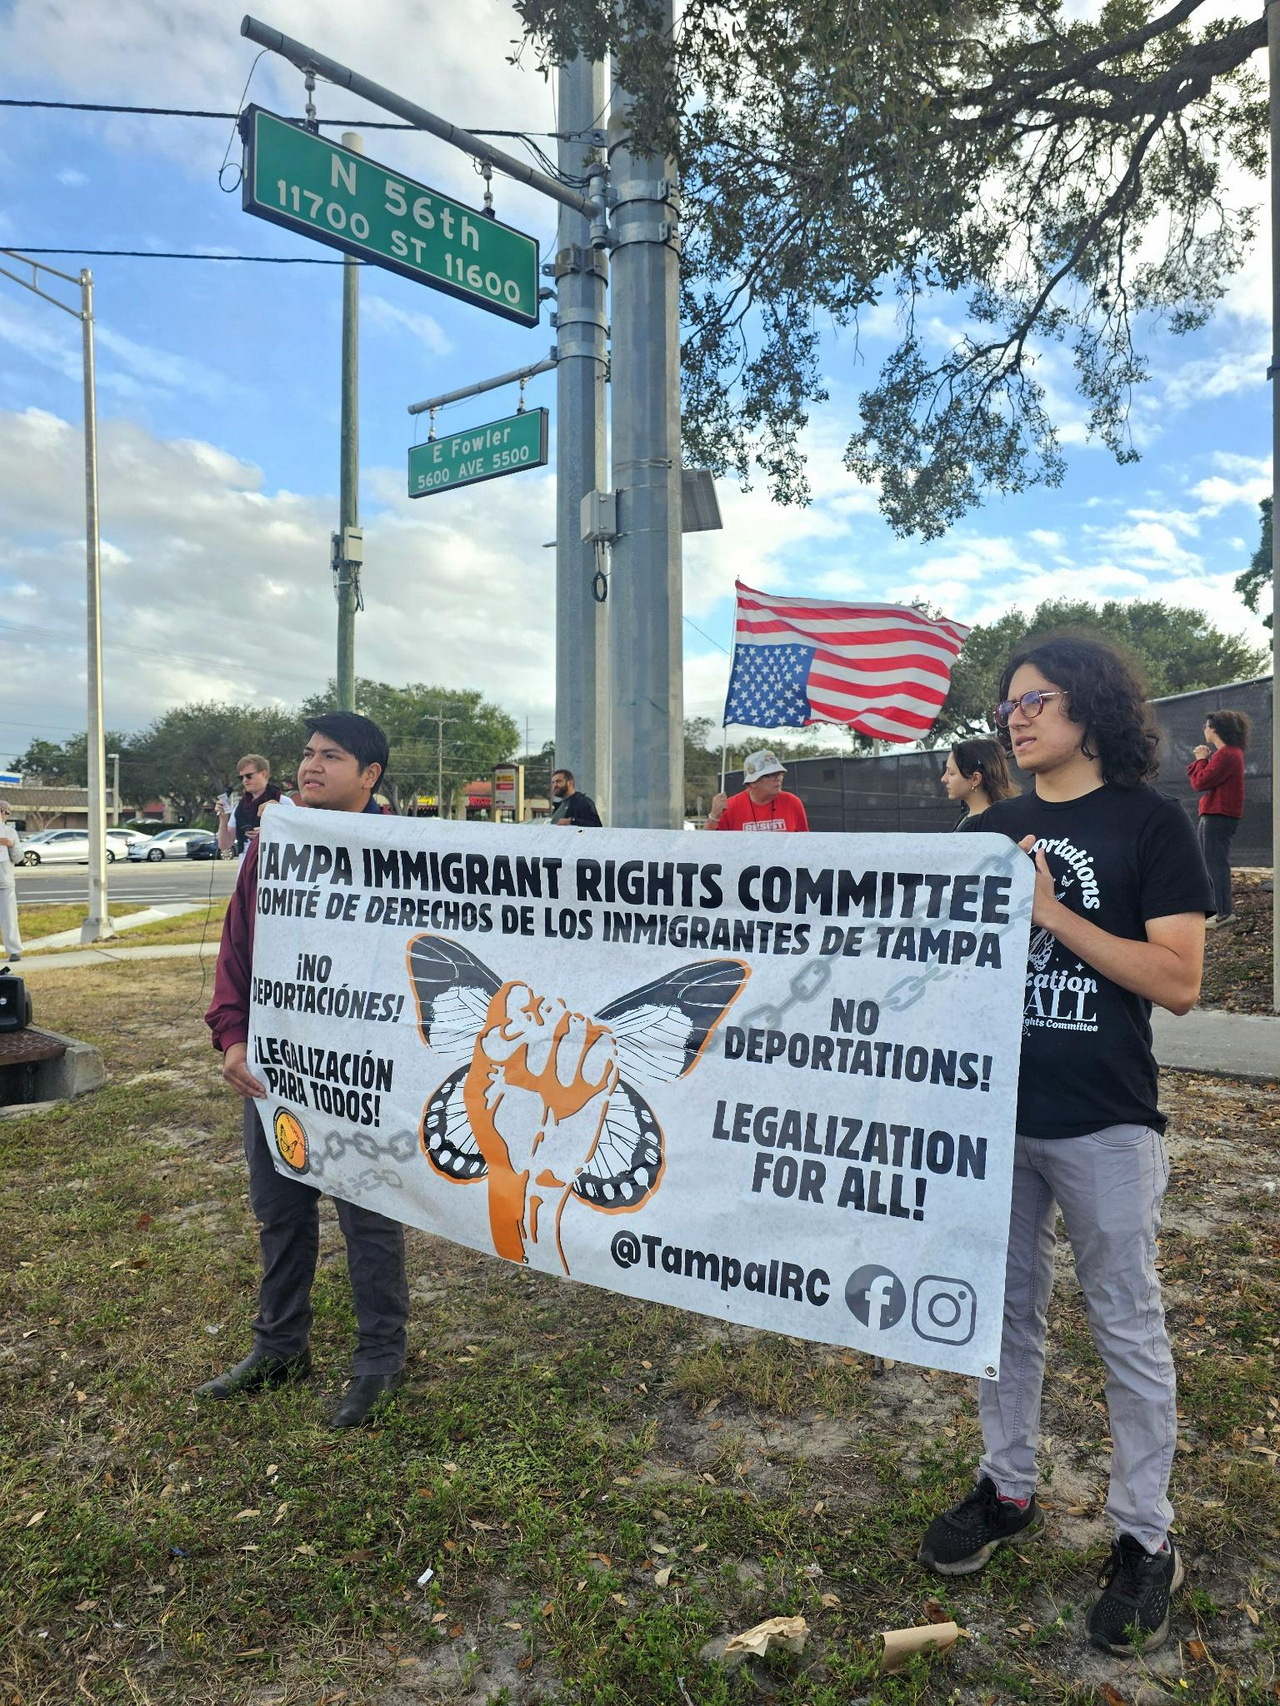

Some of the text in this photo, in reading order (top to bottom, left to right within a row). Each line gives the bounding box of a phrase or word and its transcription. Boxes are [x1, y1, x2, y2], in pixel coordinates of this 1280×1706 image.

[331, 154, 479, 252] N 56th
[276, 179, 521, 304] 11700 ST 11600
[417, 445, 530, 490] 5600 AVE 5500
[432, 425, 512, 464] E Fowler
[258, 841, 1012, 925] TAMPA IMMIGRANT RIGHTS COMMITTEE
[1028, 837, 1100, 911] ortations
[324, 891, 361, 922] DE
[365, 896, 493, 933] DERECHOS
[501, 903, 535, 936] DE
[544, 907, 594, 941] LOS
[602, 911, 811, 956] INMIGRANTES
[819, 925, 862, 958] DE
[875, 926, 1002, 969] TAMPA
[296, 953, 333, 984] ¡NO
[830, 997, 880, 1036] NO
[1022, 1016, 1099, 1033] ghts Committee
[1023, 987, 1097, 1022] ALL
[723, 1025, 993, 1092] DEPORTATIONS!
[262, 1066, 381, 1128] PARA TODOS!
[712, 1100, 988, 1180] LEGALIZATION
[751, 1152, 928, 1221] FOR ALL!
[611, 1230, 831, 1307] @TampaIRC
